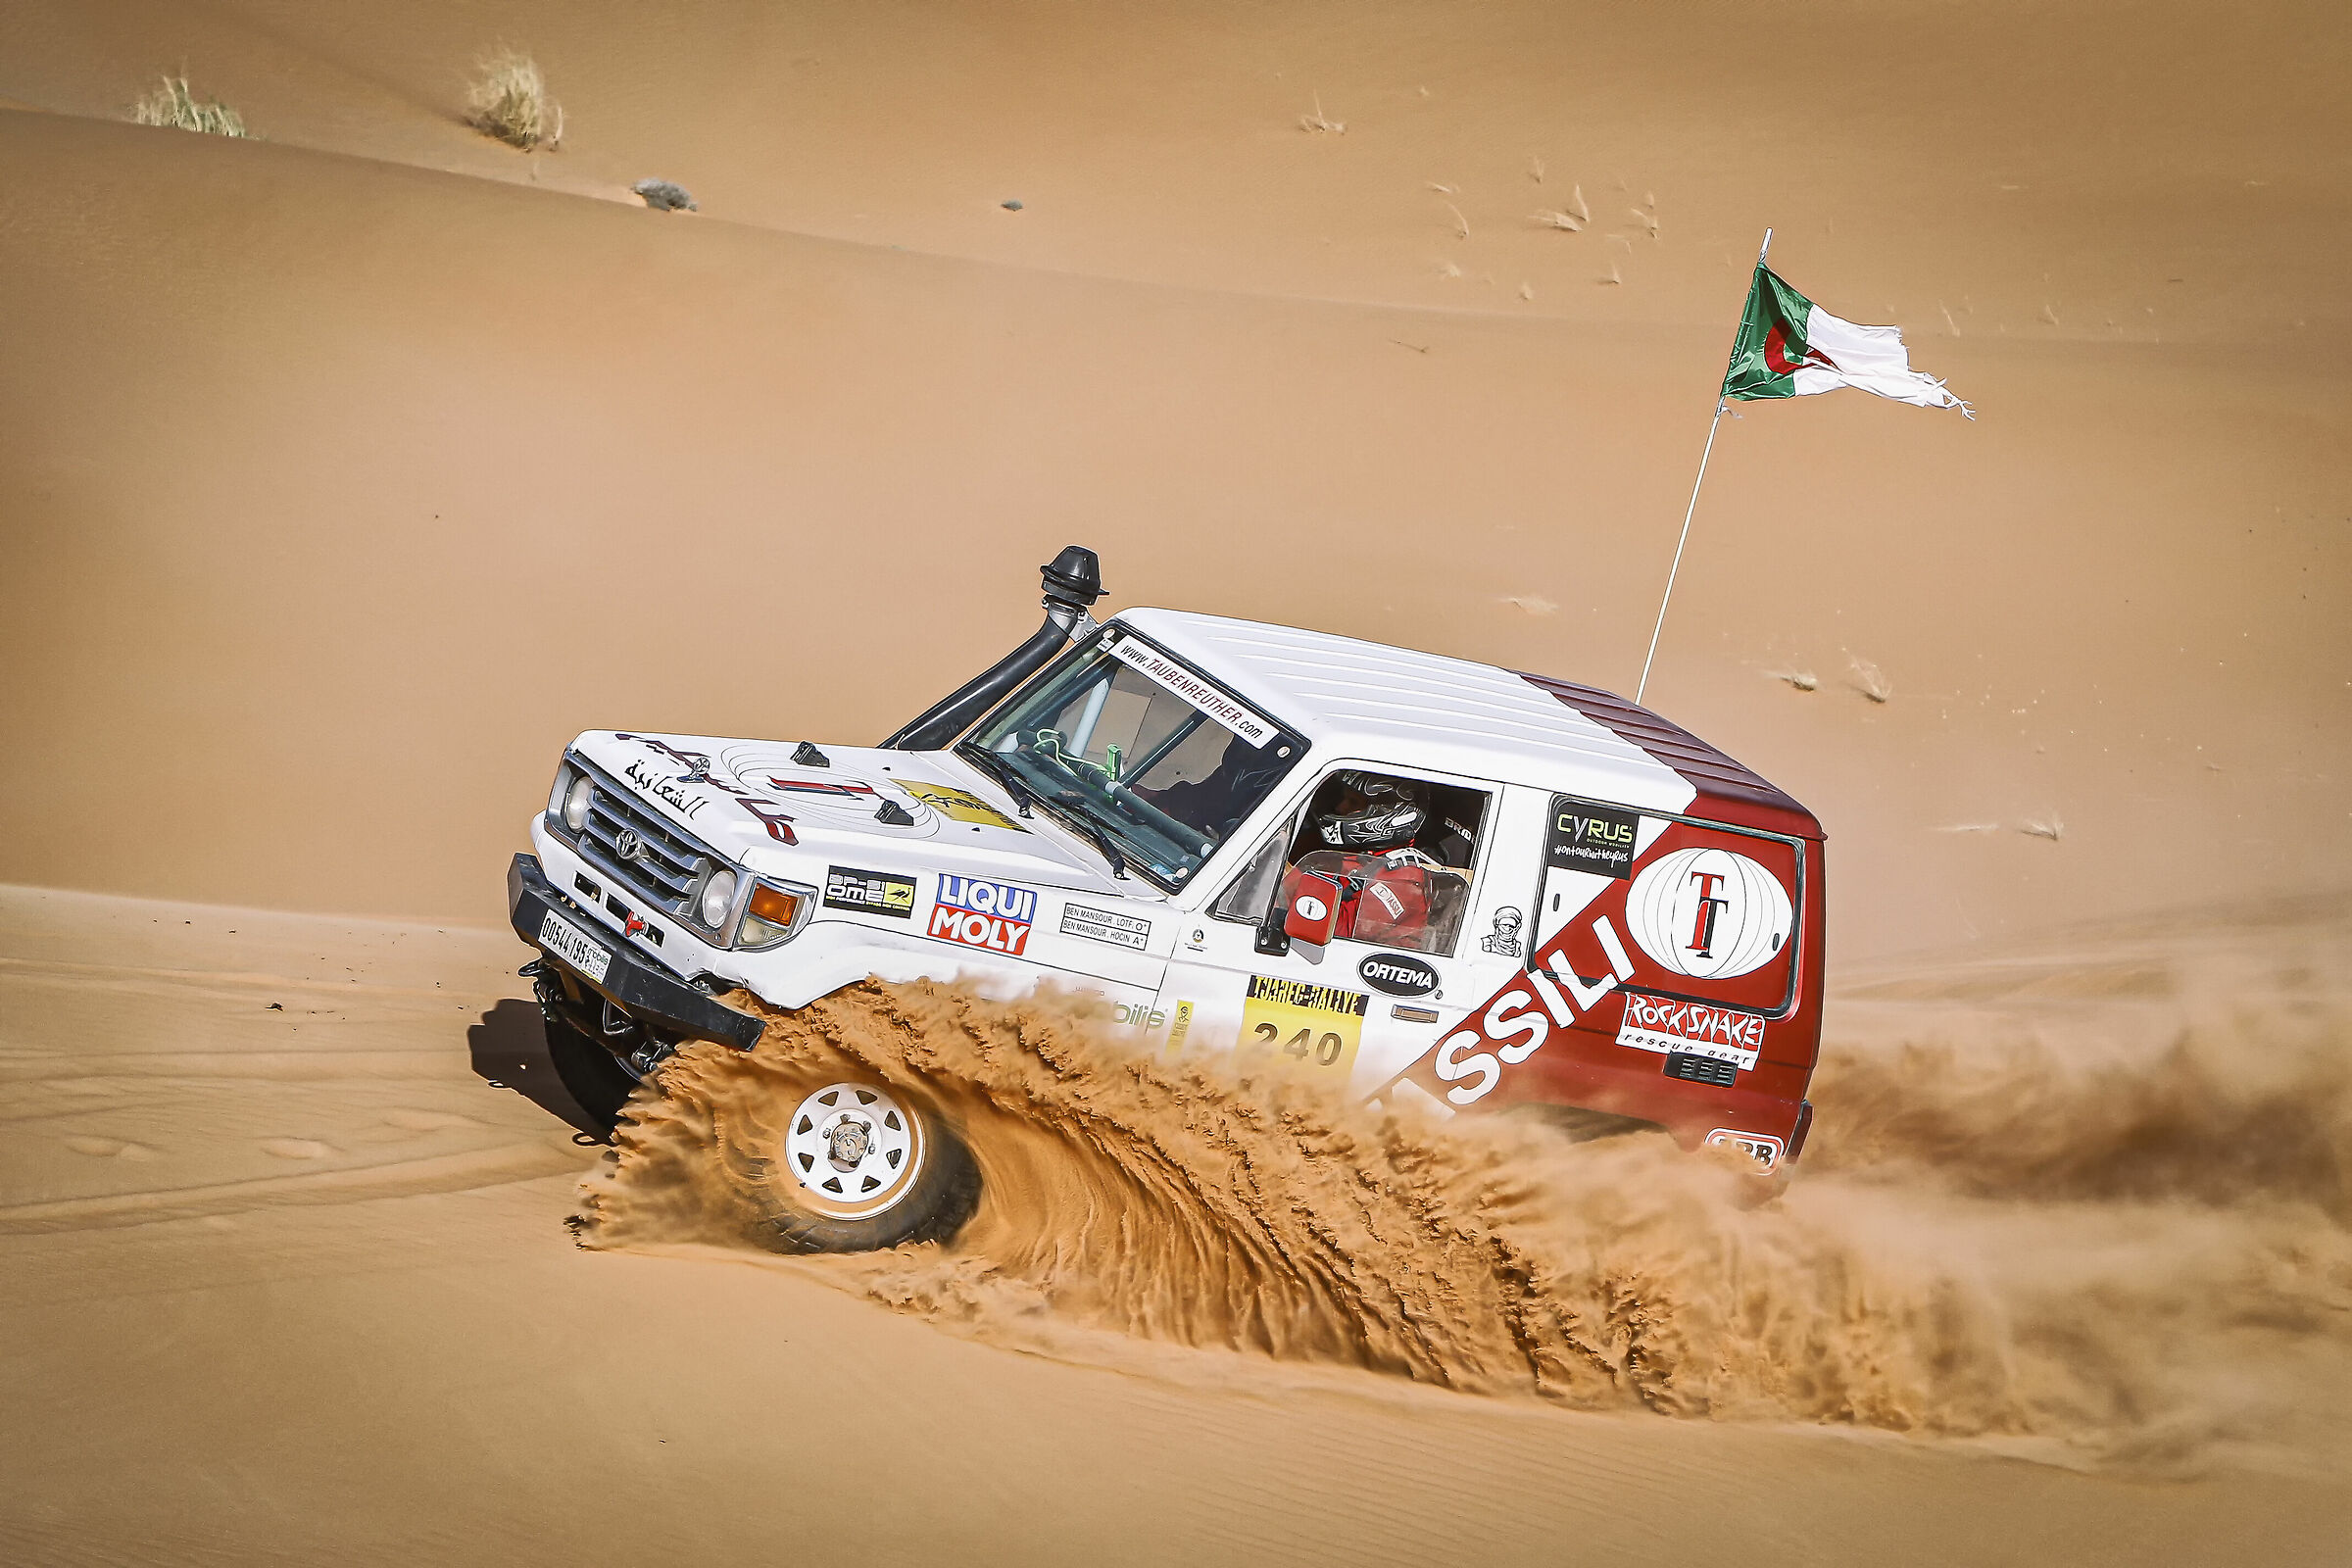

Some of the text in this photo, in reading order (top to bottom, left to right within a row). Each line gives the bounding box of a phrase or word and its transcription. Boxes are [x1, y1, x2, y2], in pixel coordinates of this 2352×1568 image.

[1120, 644, 1263, 739] www.TAUBENREUTHER.com
[1557, 813, 1633, 844] CYRUS
[941, 874, 1034, 921] LIQUI
[1066, 906, 1078, 916] BEN
[1079, 909, 1113, 924] MANSOUR
[931, 906, 1031, 953] MOLY
[1063, 919, 1076, 930] BEN
[1076, 922, 1107, 937] MANSOUR
[1362, 960, 1433, 989] ORTEMA
[1392, 914, 1636, 1113] SSILI
[1254, 1022, 1343, 1066] 240
[1624, 1033, 1693, 1053] rescue
